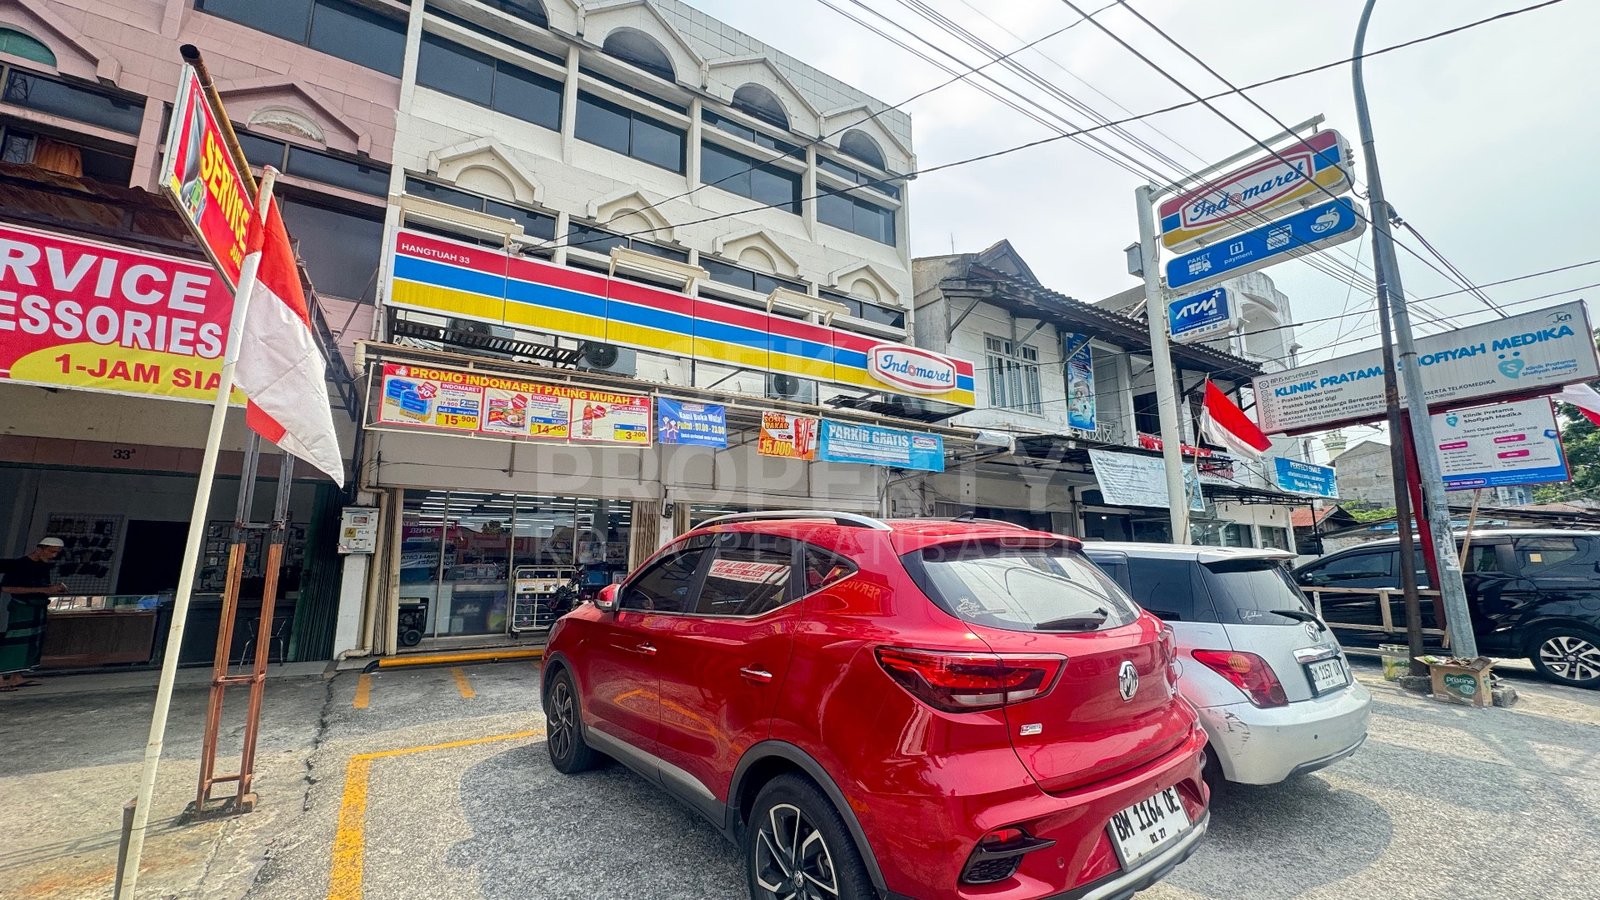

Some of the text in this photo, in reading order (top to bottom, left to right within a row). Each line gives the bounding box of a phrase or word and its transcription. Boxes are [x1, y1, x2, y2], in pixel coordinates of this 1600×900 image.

[202, 130, 250, 251] SERVICE
[1189, 161, 1304, 221] Indomaret
[401, 242, 470, 264] HANGTUAH 33
[1187, 252, 1211, 264] PAKET
[1224, 251, 1254, 265] payment
[55, 353, 235, 393] 1-JAM SIA
[880, 354, 951, 383] Indomaret
[1275, 380, 1318, 397] KLINIK
[1320, 366, 1385, 388] PRATAM
[1492, 325, 1574, 352] MEDIKA
[410, 368, 630, 405] PROMO INDOMARET PALING MURAH
[441, 383, 480, 393] INDOMARET
[762, 438, 792, 456] 15.000
[872, 431, 909, 448] GRATIS
[1113, 810, 1136, 842] BM
[1132, 795, 1165, 832] 1164
